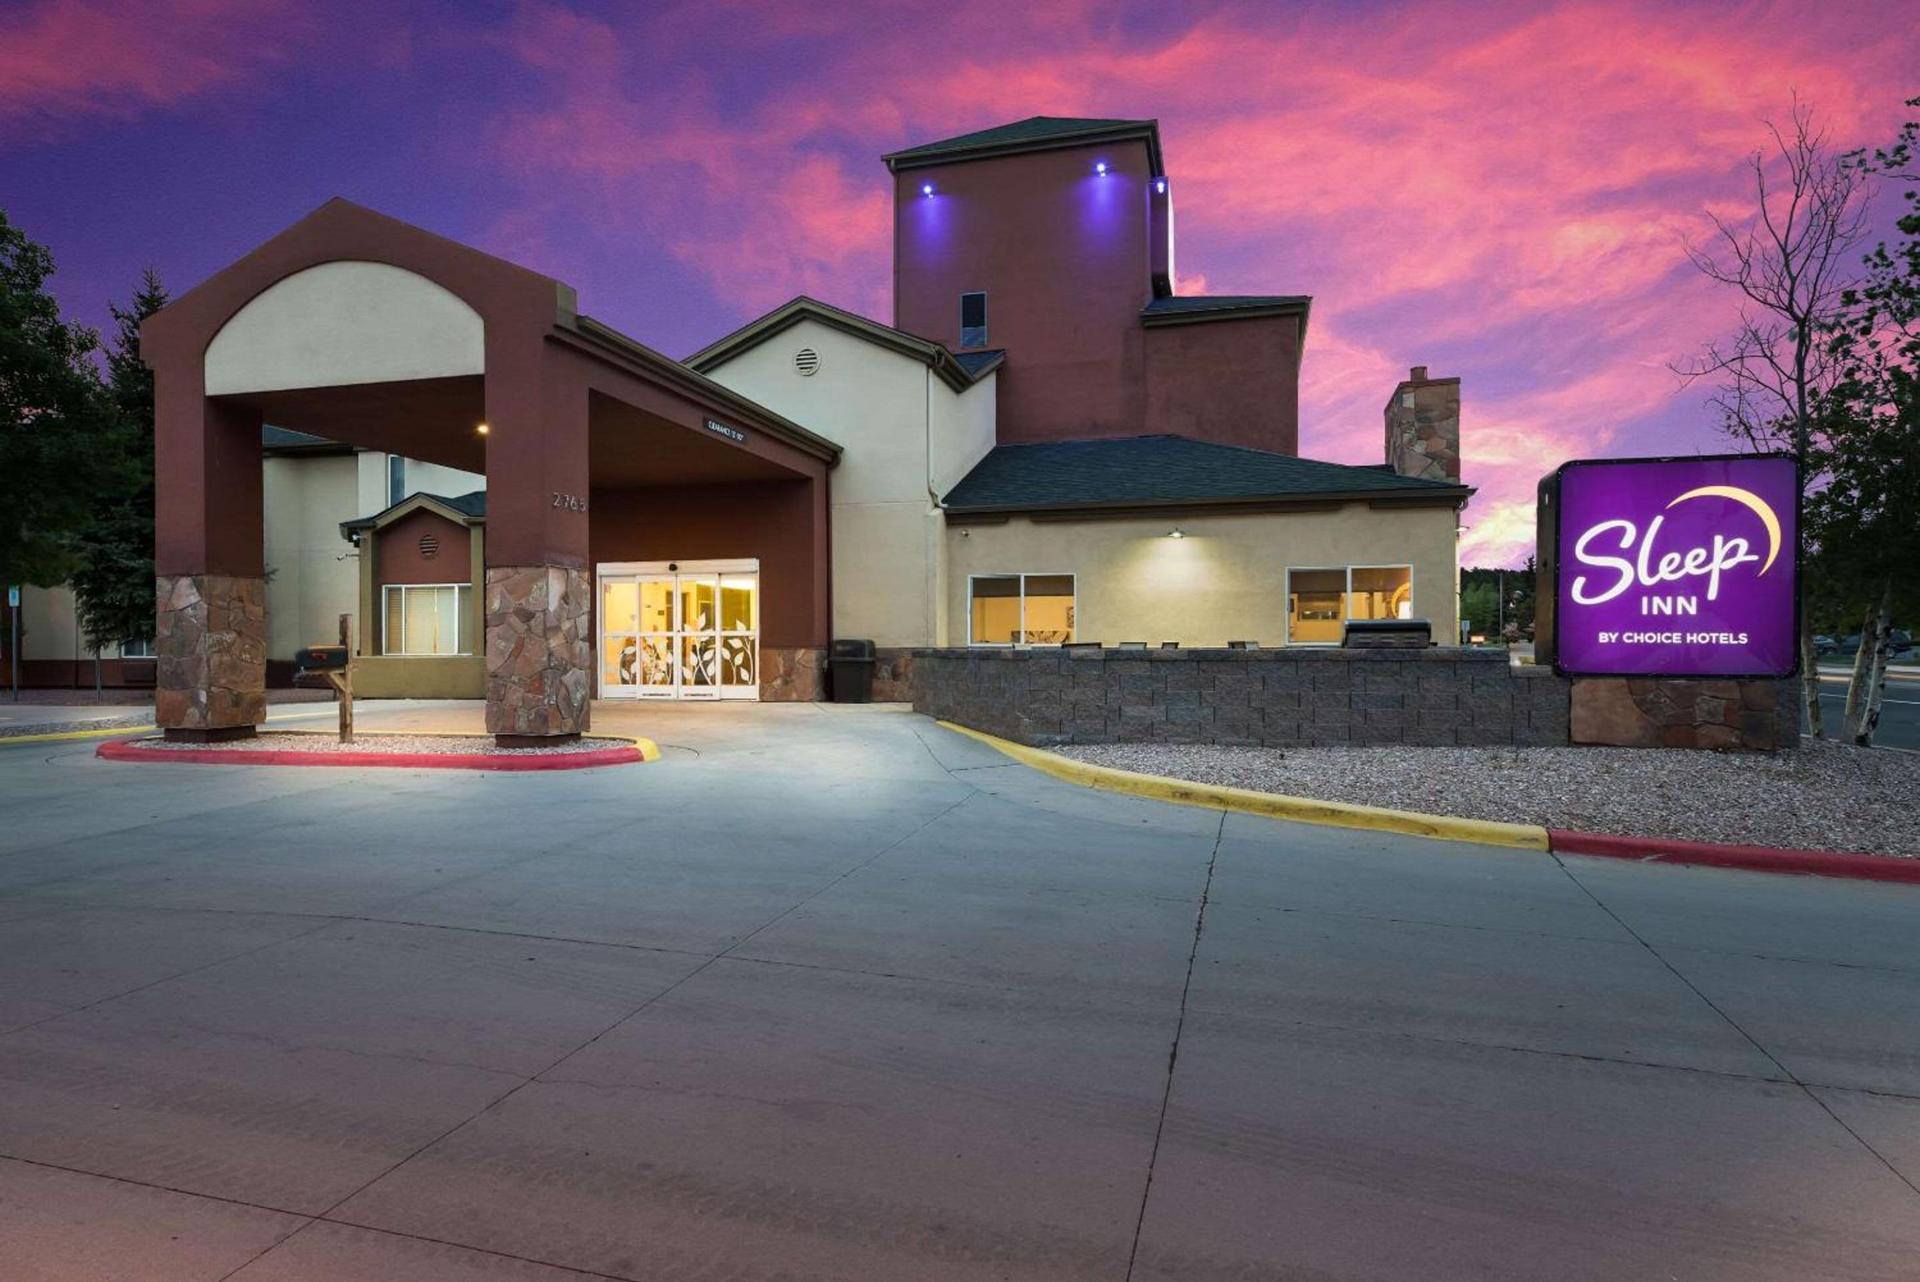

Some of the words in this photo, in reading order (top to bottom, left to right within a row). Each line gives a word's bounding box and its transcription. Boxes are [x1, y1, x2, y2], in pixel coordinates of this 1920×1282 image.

[1571, 515, 1759, 605] Sleep
[1641, 596, 1697, 615] INN
[1598, 632, 1619, 644] BY
[1622, 632, 1682, 644] CHOICE
[1686, 632, 1748, 645] HOTELS
